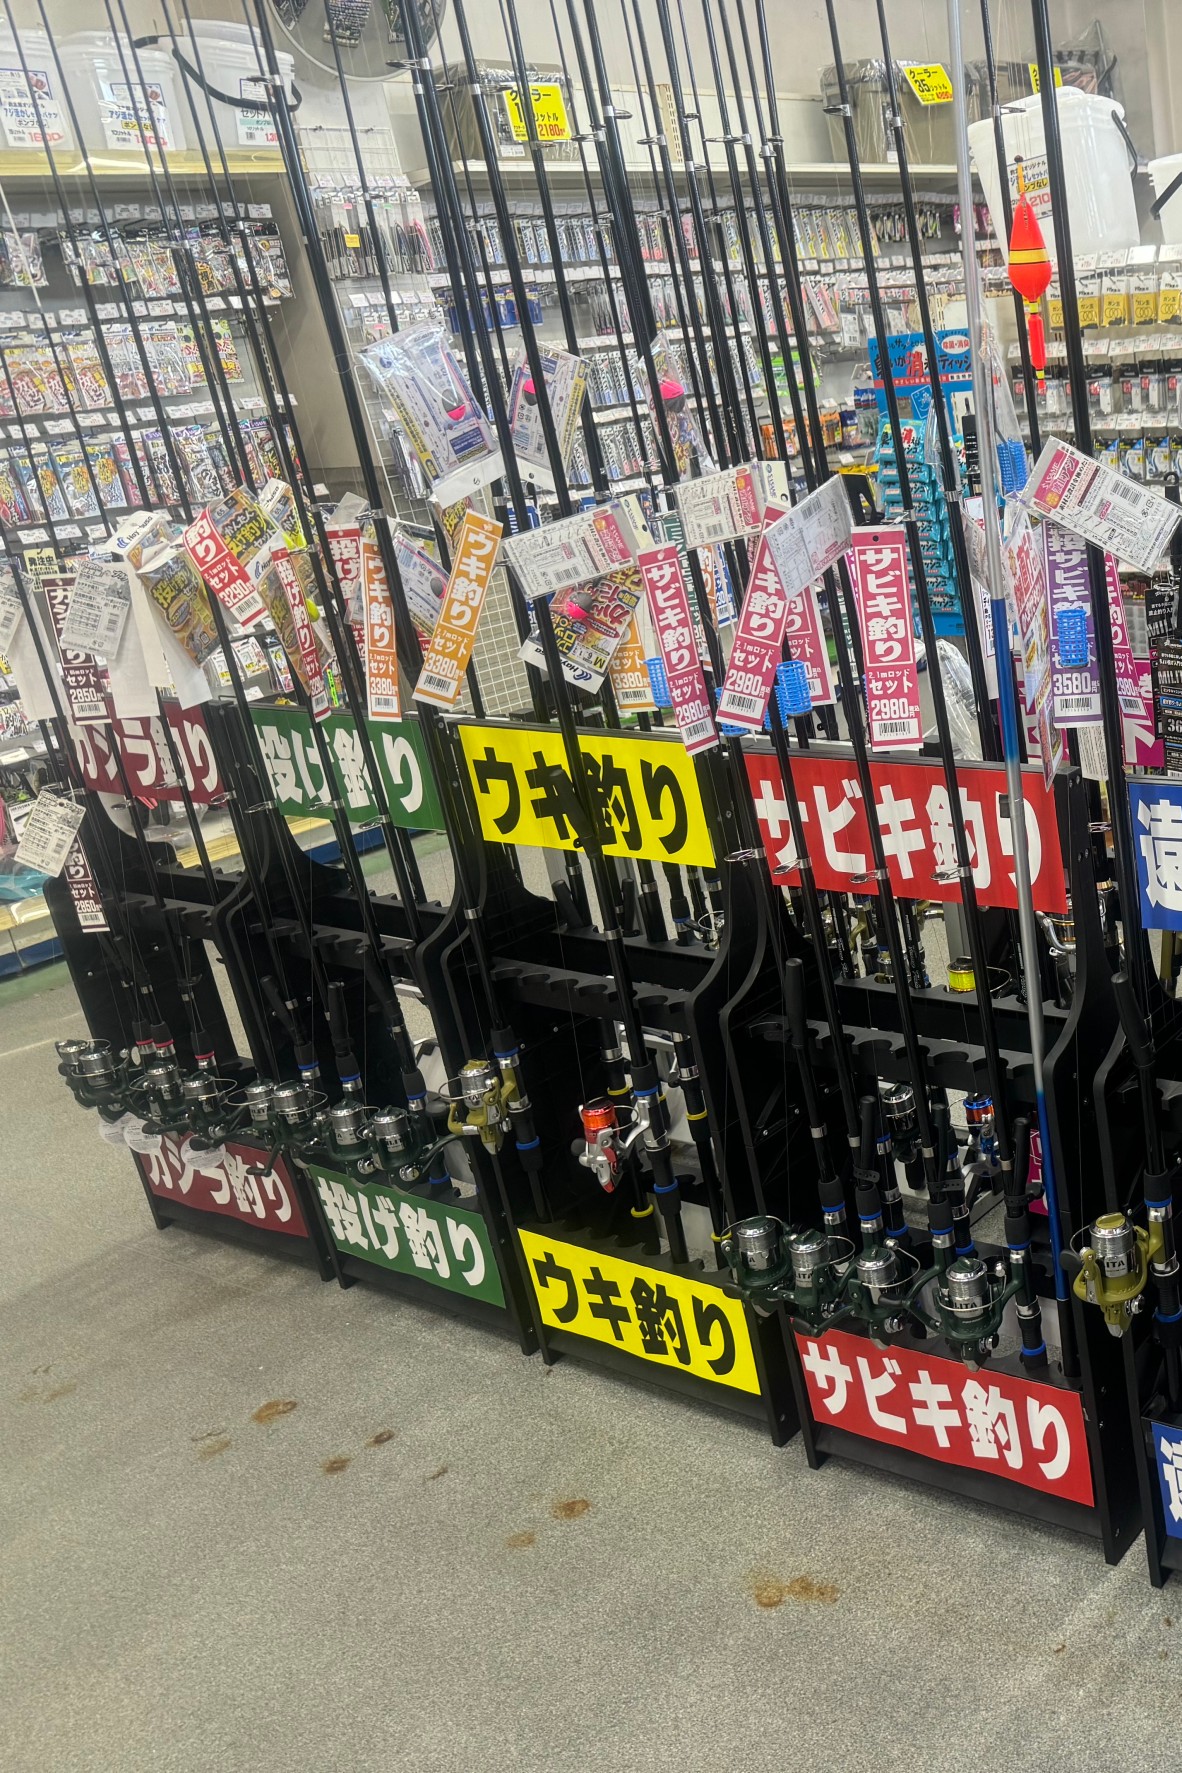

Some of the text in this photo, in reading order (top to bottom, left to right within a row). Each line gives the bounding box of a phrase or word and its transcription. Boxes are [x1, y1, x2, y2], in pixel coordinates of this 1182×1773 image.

[909, 68, 938, 79] クーラー
[509, 88, 552, 102] クラー
[209, 562, 239, 589] セット
[449, 532, 494, 627] ウキ釣り
[219, 579, 250, 608] 3290
[367, 558, 392, 648] ウキ釣り
[859, 549, 903, 662] サビキ釣り
[648, 562, 692, 671] サビキ釣り
[433, 635, 468, 658] セット
[369, 661, 395, 675] セット
[425, 652, 458, 677] 3380
[732, 649, 773, 673] セット
[66, 674, 97, 687] セット
[370, 677, 392, 694] 3380
[671, 679, 702, 702] セット
[726, 669, 762, 696] 2980
[869, 676, 914, 695] セット
[1053, 672, 1092, 695] 3580
[69, 687, 97, 704] 2850
[677, 701, 704, 724] 2980
[871, 698, 908, 720] 2980
[254, 725, 423, 812] 投げ釣り
[472, 747, 689, 854] ウキ釣り
[756, 778, 1042, 889] サビキ釣り
[71, 887, 96, 898] セット
[75, 900, 97, 913] 2850
[317, 1174, 486, 1287] 投げ釣り
[532, 1251, 736, 1377] ウキ釣り
[804, 1341, 1071, 1480] サビキ釣り
